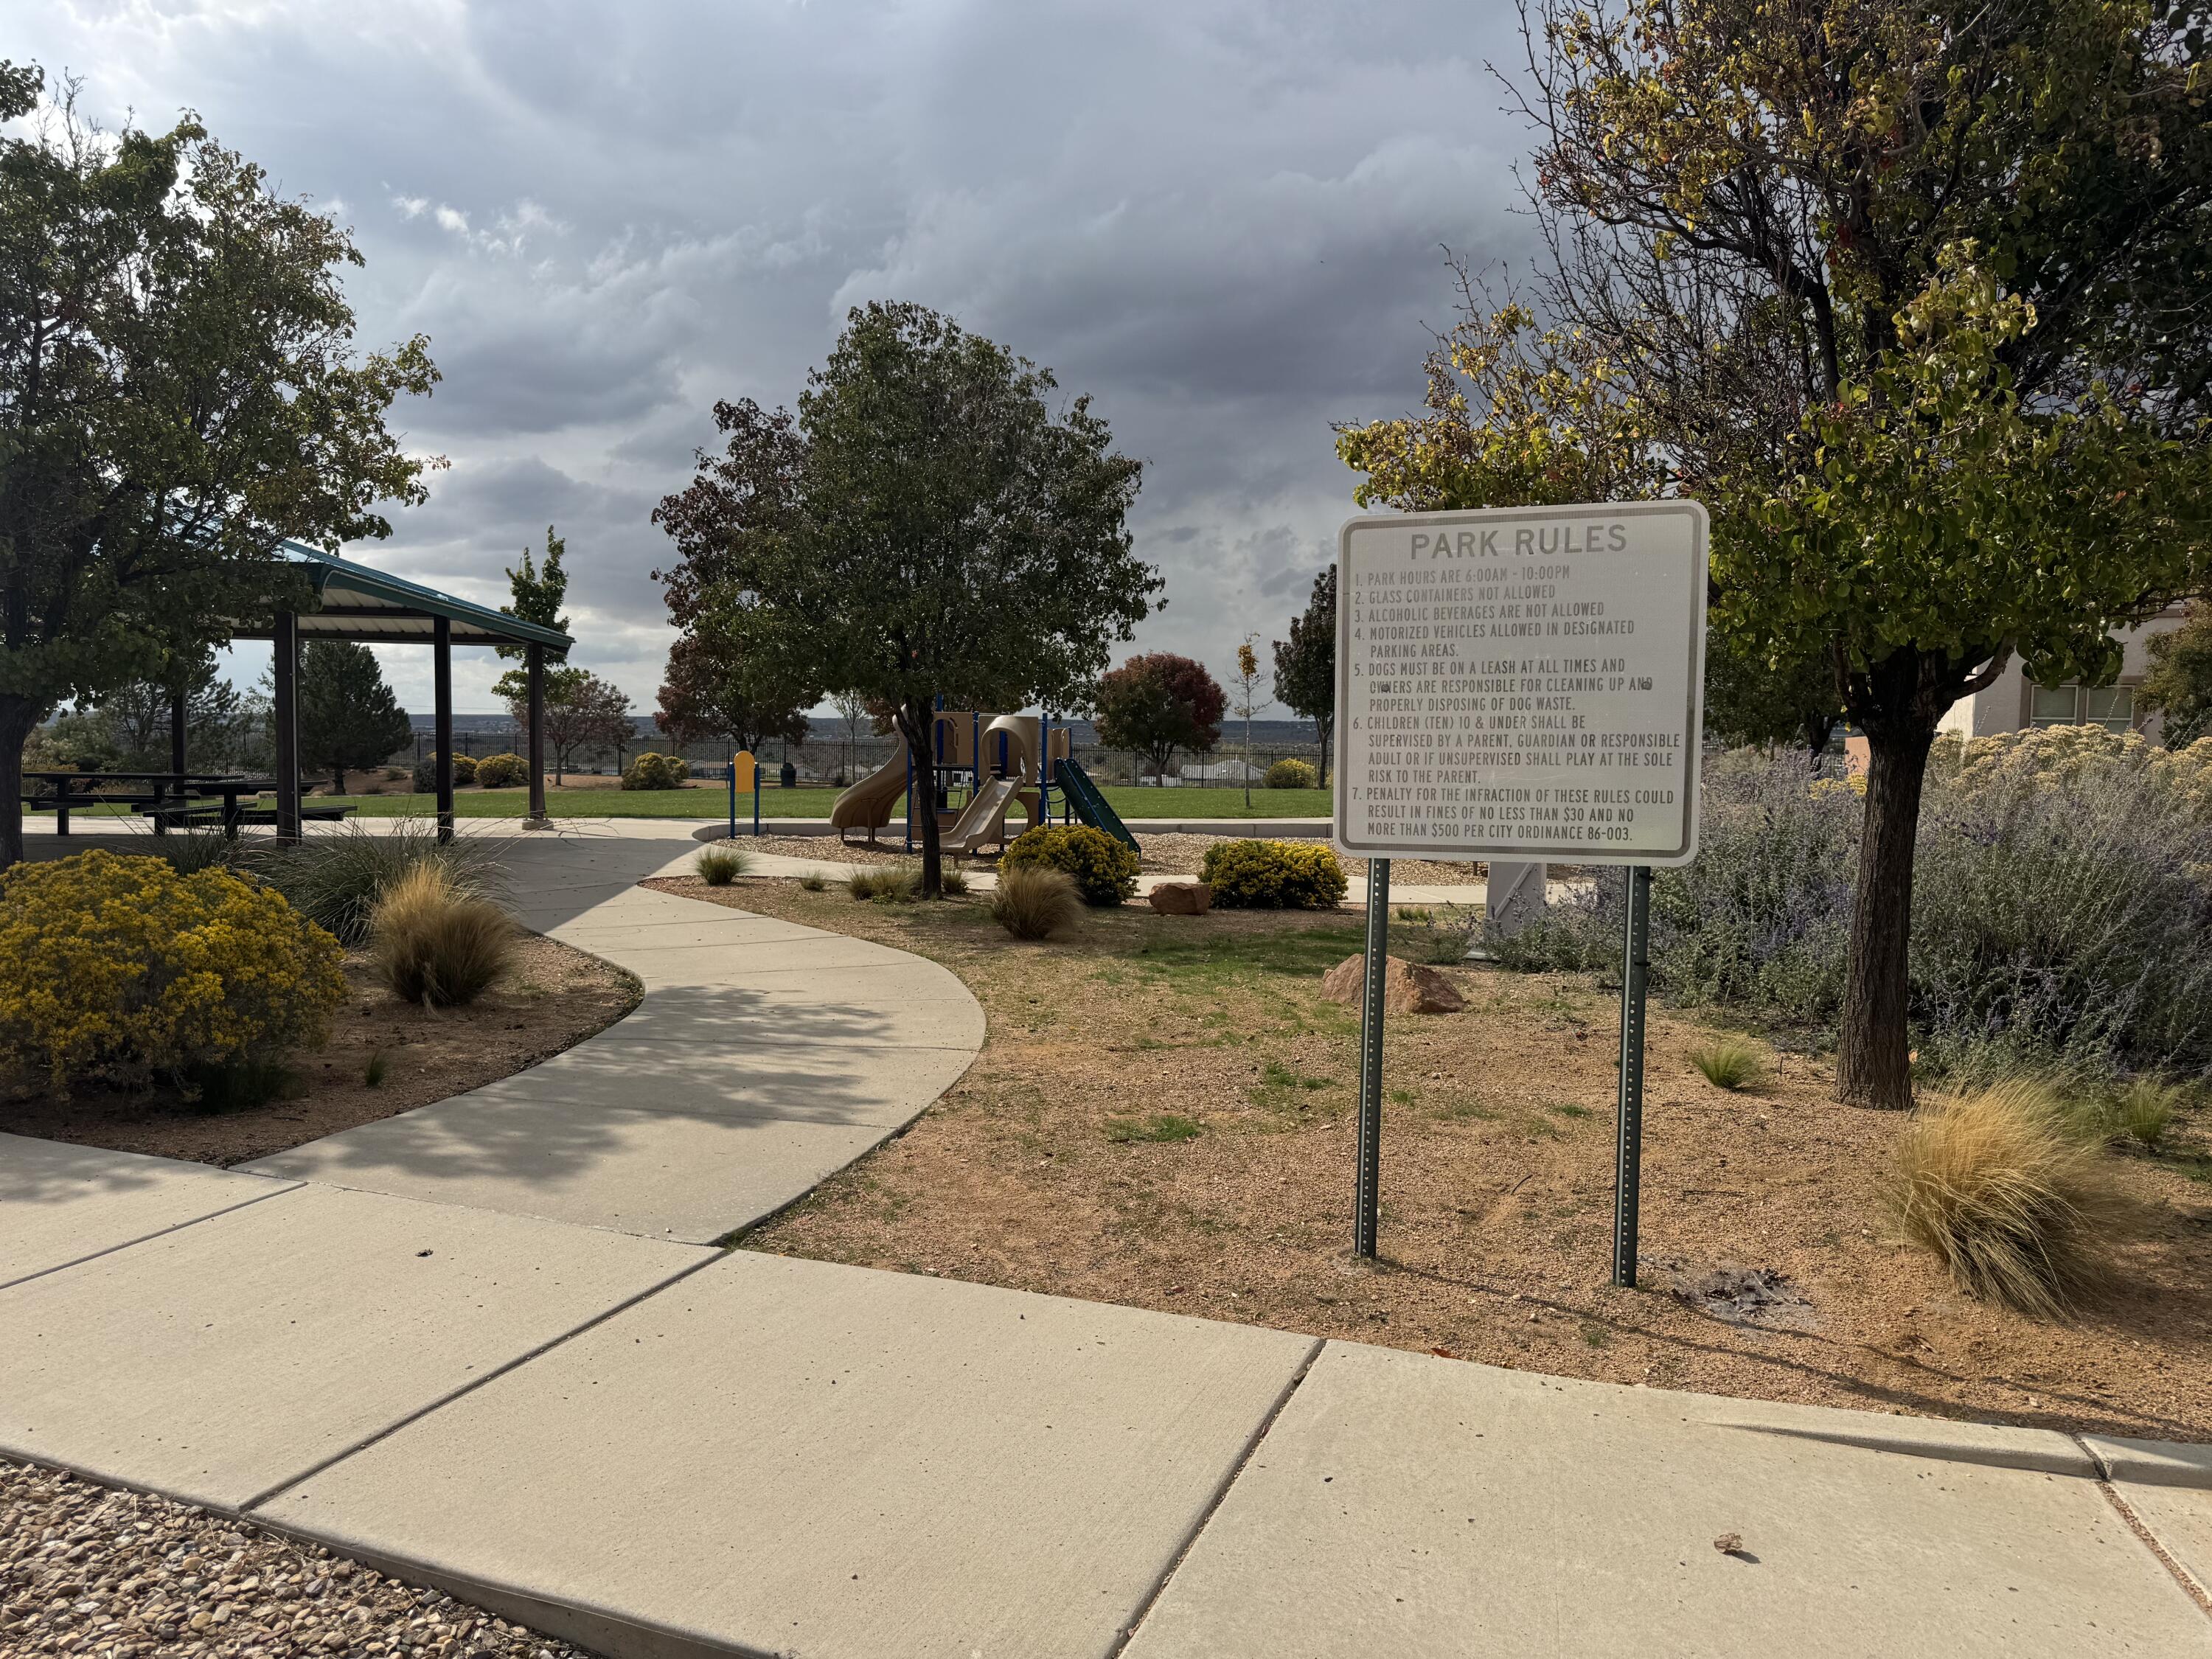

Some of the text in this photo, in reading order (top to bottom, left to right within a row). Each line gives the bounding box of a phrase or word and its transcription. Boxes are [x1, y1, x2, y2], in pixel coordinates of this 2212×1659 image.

[1411, 524, 1627, 560] PARK RULES
[1356, 574, 1363, 587] 1.
[1368, 571, 1395, 585] PARK
[1400, 571, 1435, 585] HOURS
[1441, 569, 1461, 583] ARE
[1466, 568, 1507, 582] 6:00AM
[1522, 566, 1570, 580] 10:00PM
[1355, 585, 1555, 605] 2. GLASS CONTAINERS NOT ALLOWED
[1354, 602, 1604, 622] 3. ALCOHOLIC BEVERAGES ARE NOT ALLOWED
[1354, 620, 1634, 640] 4. MOTORIZED VEHICLES ALLOWED IN DESIGNATED
[1371, 644, 1458, 658] PARKING AREAS.
[1354, 658, 1624, 676] 5. DOGS MUST BE ON A LEASH AT ALL TIMES AND
[1416, 681, 1436, 693] ARE
[1442, 679, 1515, 692] RESPONSIBLE
[1521, 678, 1541, 692] FOR
[1547, 678, 1603, 692] CLEANING
[1610, 678, 1624, 691] UP
[1370, 697, 1575, 712] PROPERLY DISPOSING OF DOG WASTE.
[1353, 715, 1585, 729] 6. CHILDREN (TEN) 10 & UNDER SHALL BE
[1368, 734, 1432, 747] SUPERVISED
[1438, 734, 1450, 747] BY
[1456, 734, 1462, 747] A
[1518, 734, 1575, 748] GUARDIAN
[1582, 734, 1595, 747] OR
[1601, 734, 1680, 748] RESPONSIBLE
[1368, 752, 1672, 766] ADULT OR IF UNSUPERVISED SHALL PLAY AT THE SOLE
[1368, 770, 1481, 784] RISK TO THE PARENT.
[1352, 787, 1674, 804] 7. PENALTY FOR THE INFRACTION OF THESE RULES COULD
[1368, 805, 1633, 822] RESULT IN FINES OF NO LESS THAN $30 AND NO
[1368, 823, 1632, 841] MORE THAN $500 PER CITY ORDINANCE 86-003.
